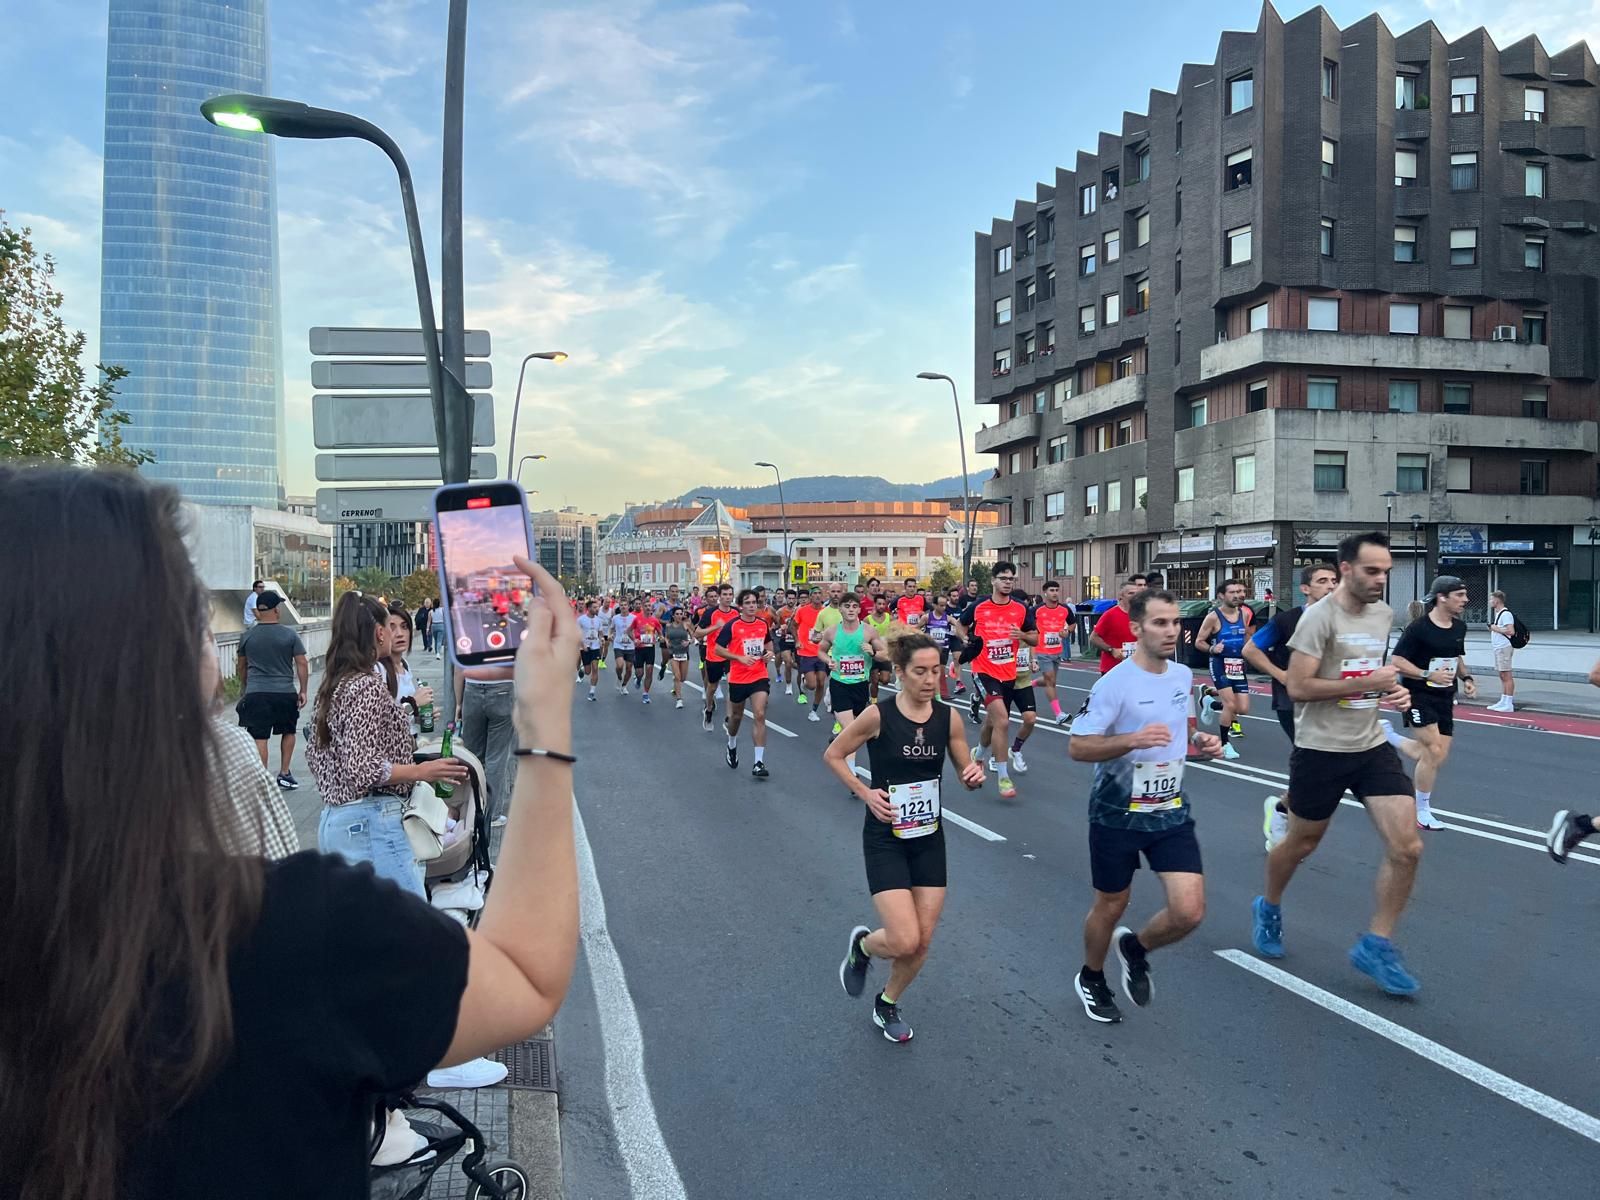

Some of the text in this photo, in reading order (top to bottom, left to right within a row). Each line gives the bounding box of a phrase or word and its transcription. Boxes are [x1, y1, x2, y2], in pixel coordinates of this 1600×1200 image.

[902, 745, 938, 756] SOUL
[1143, 776, 1177, 793] 1102
[900, 799, 933, 817] 1221
